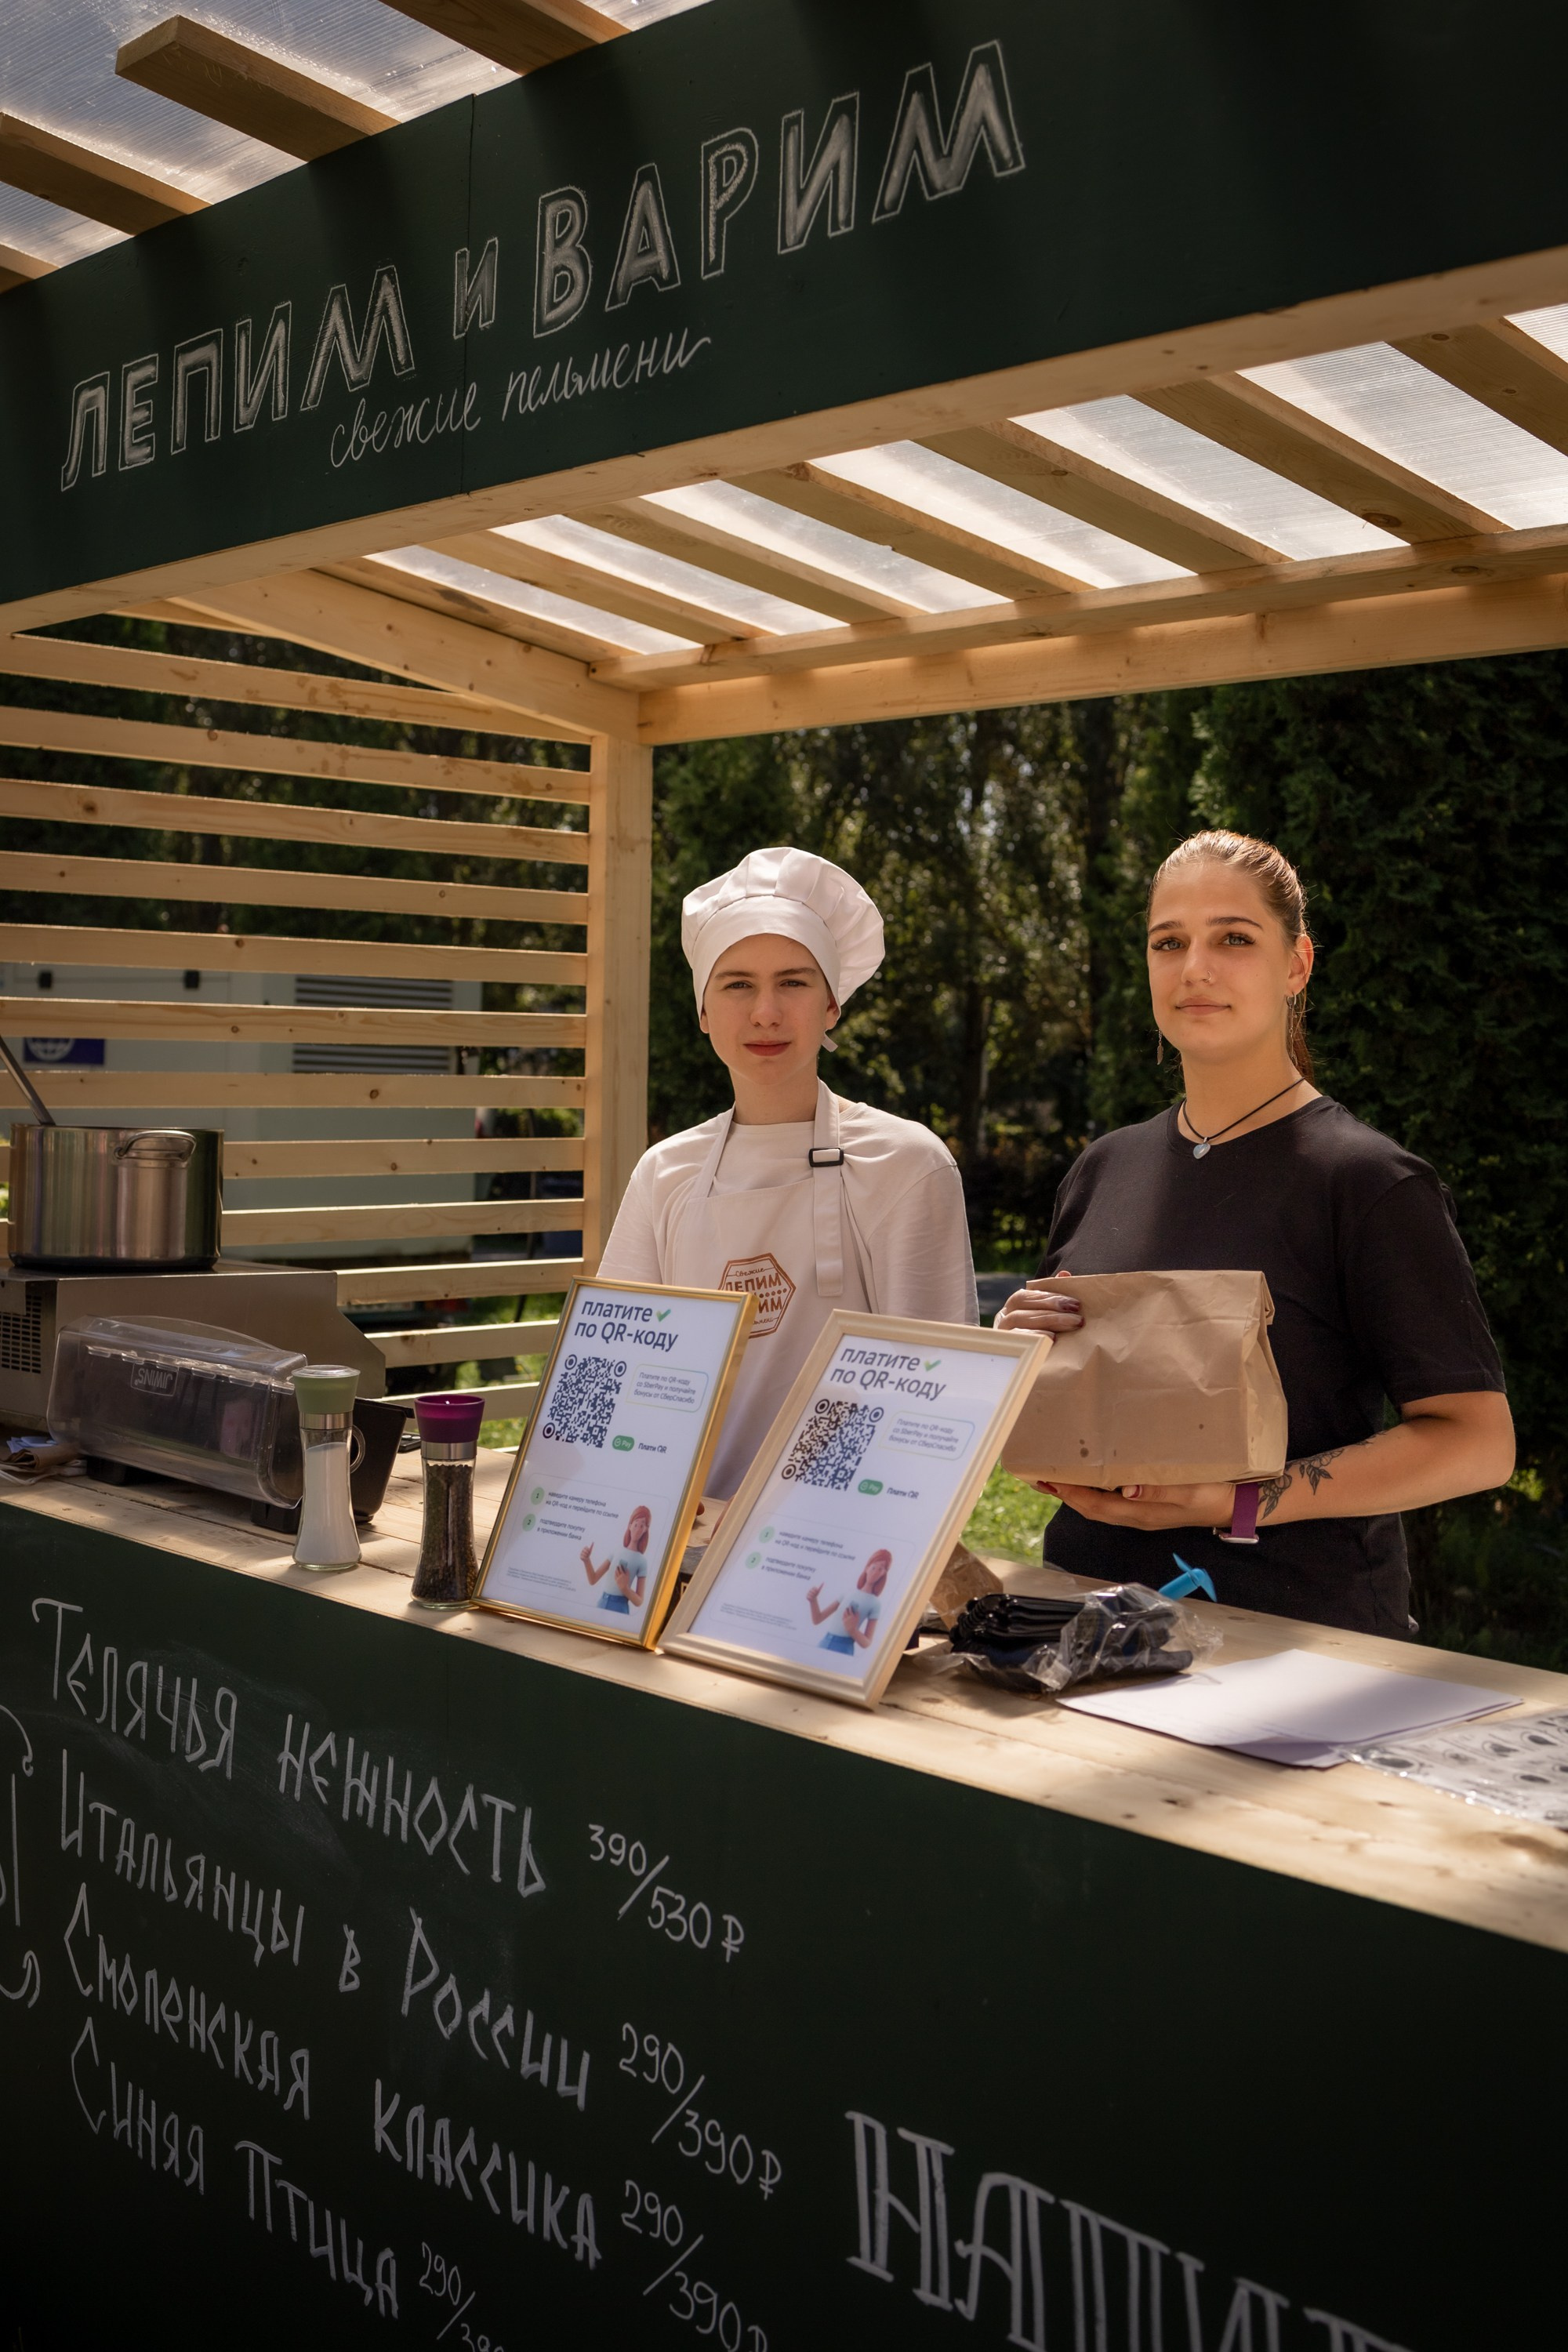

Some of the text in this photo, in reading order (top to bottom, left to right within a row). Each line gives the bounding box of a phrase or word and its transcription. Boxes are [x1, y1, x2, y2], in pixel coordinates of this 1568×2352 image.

[61, 264, 416, 492] ЛЕПИМ
[533, 39, 1025, 338] ВАРИМ
[330, 328, 712, 469] свежие пельмени
[581, 1301, 653, 1322] платите
[574, 1322, 679, 1352] по QR-коду
[840, 1348, 920, 1371] платите
[830, 1368, 946, 1401] по QR-коду
